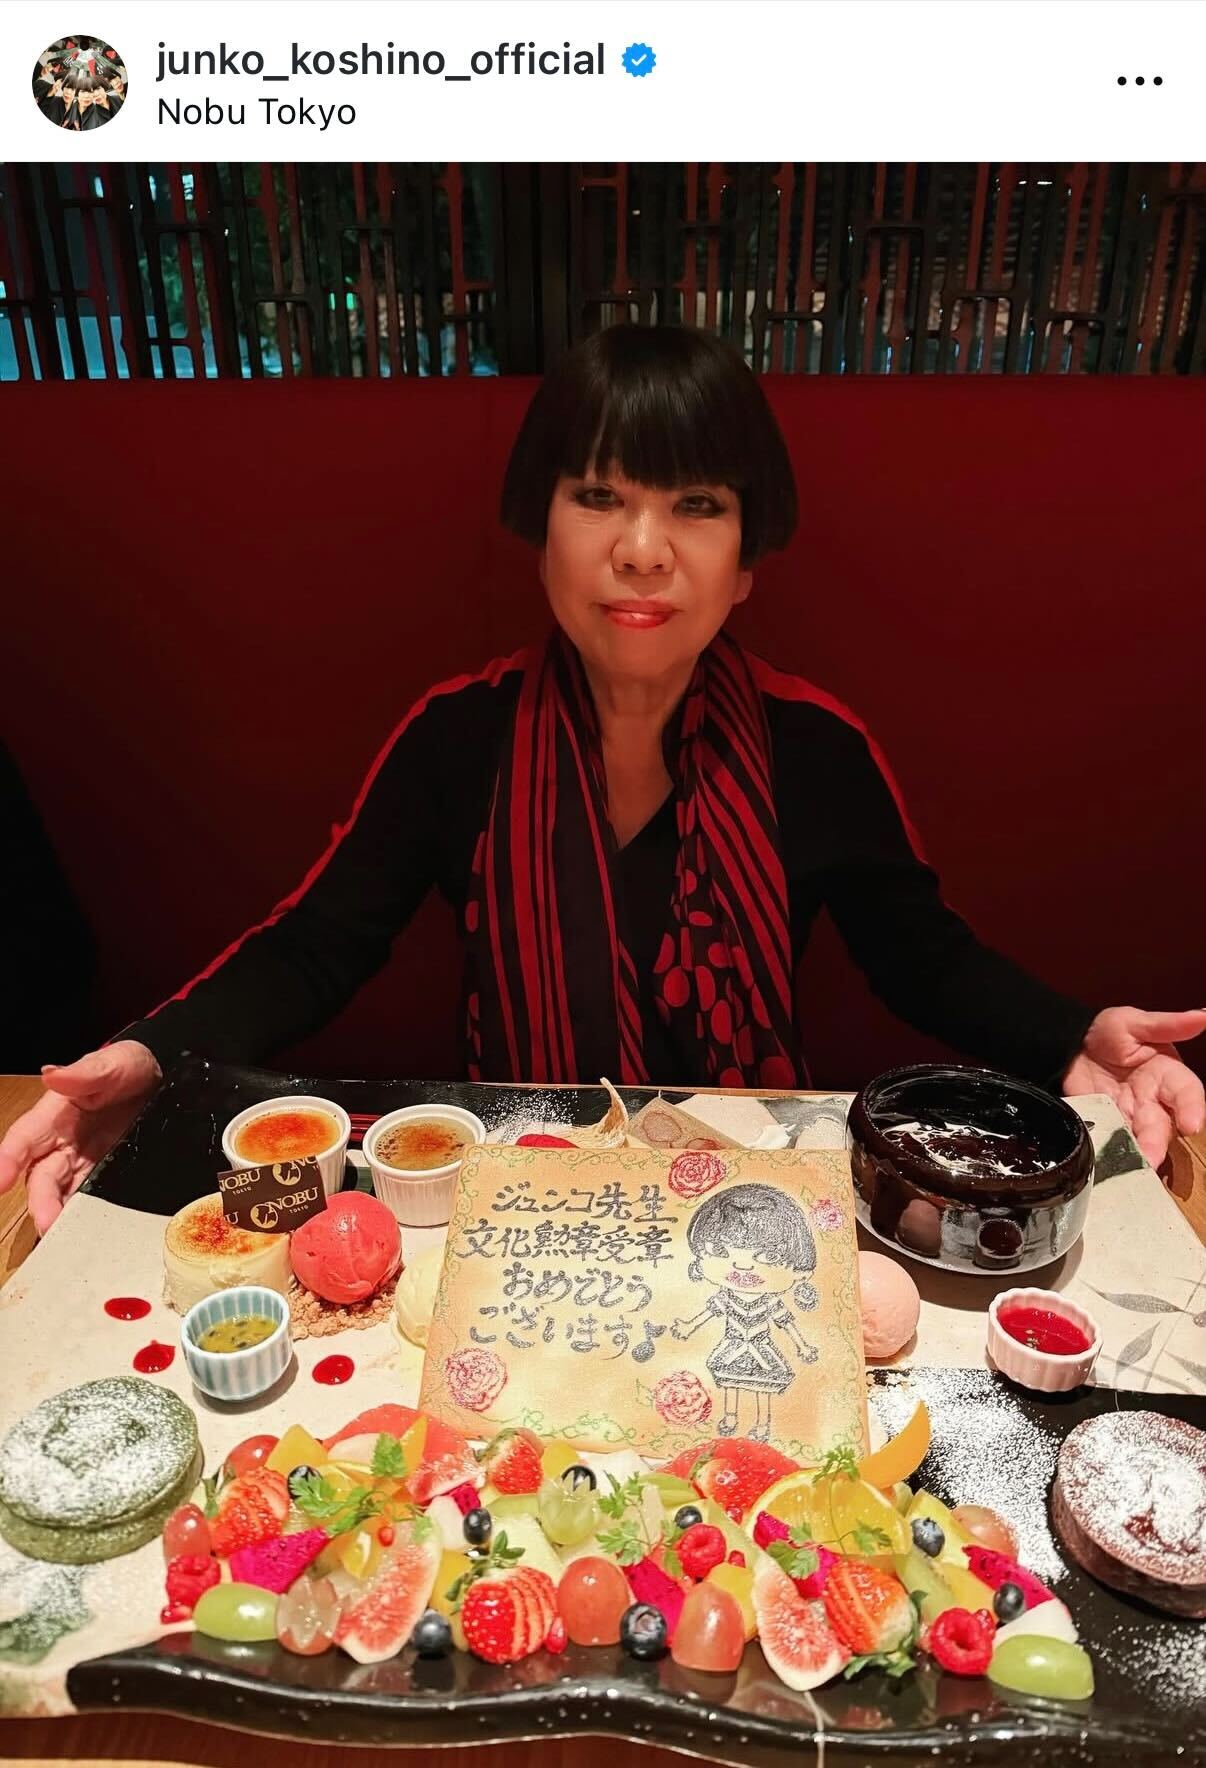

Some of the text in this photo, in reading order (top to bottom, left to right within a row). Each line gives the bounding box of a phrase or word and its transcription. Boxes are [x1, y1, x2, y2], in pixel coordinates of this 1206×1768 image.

[268, 1186, 318, 1214] NOBU
[491, 1181, 679, 1223] ジュンコ先生
[456, 1218, 675, 1268] 文化勲章受章
[502, 1261, 653, 1313] おめでとう
